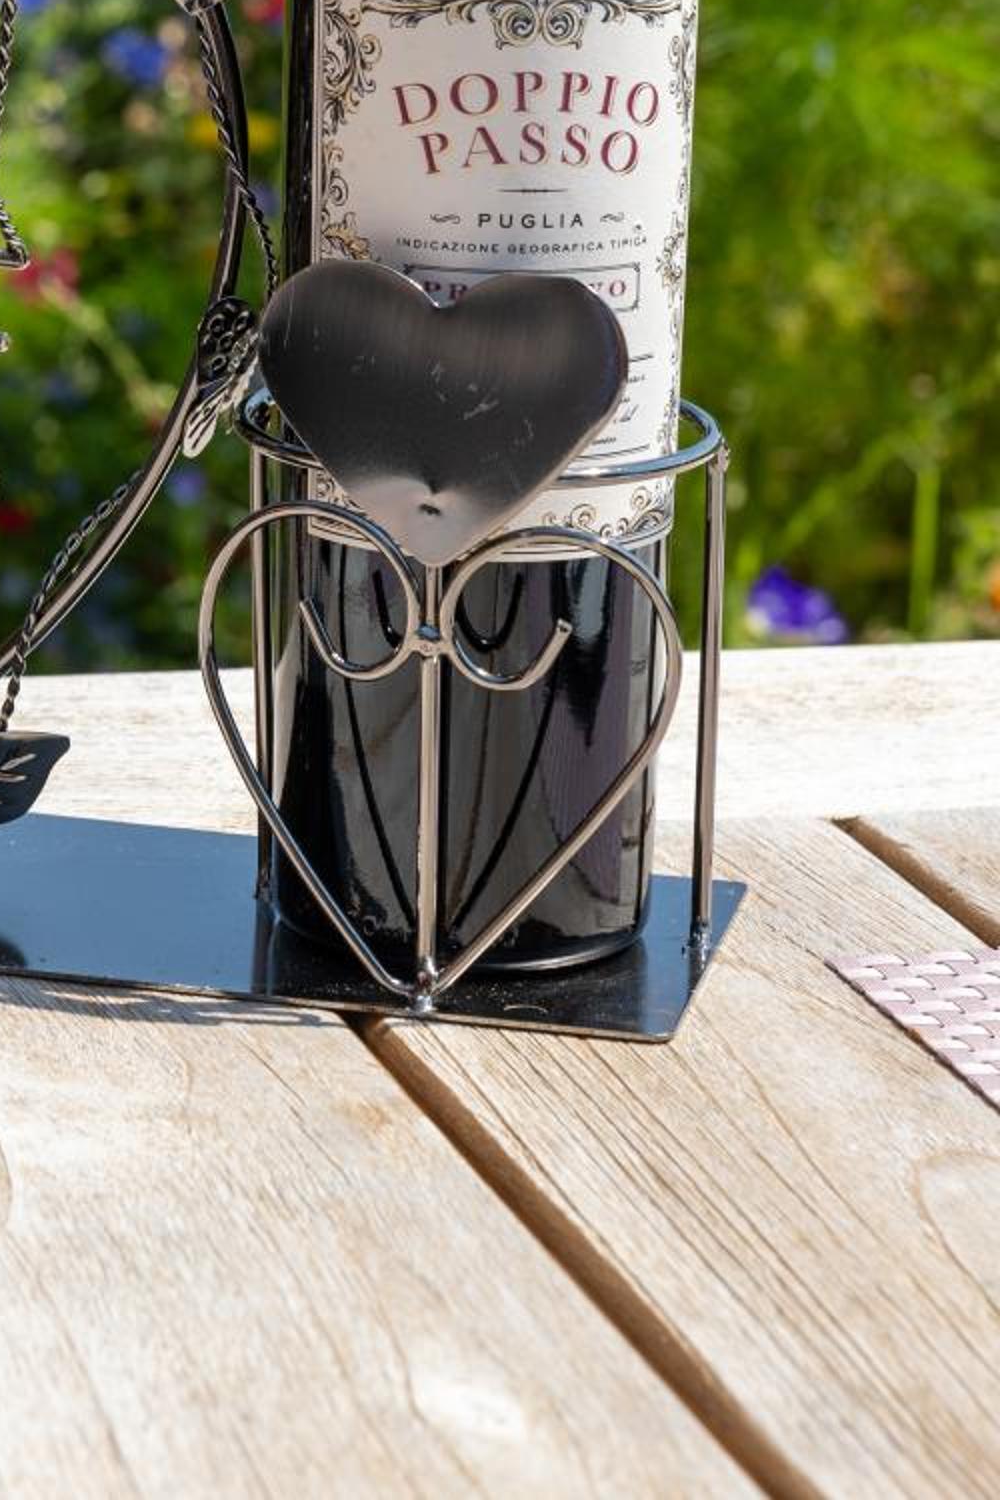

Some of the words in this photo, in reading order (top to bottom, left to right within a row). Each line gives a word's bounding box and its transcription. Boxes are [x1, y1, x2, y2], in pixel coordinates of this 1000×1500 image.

[392, 71, 660, 127] DOPPIO
[417, 122, 640, 175] PASSO
[477, 213, 584, 229] PUGLIA
[396, 237, 499, 254] INDICAZIONE
[507, 240, 604, 254] GEOGRAFICA
